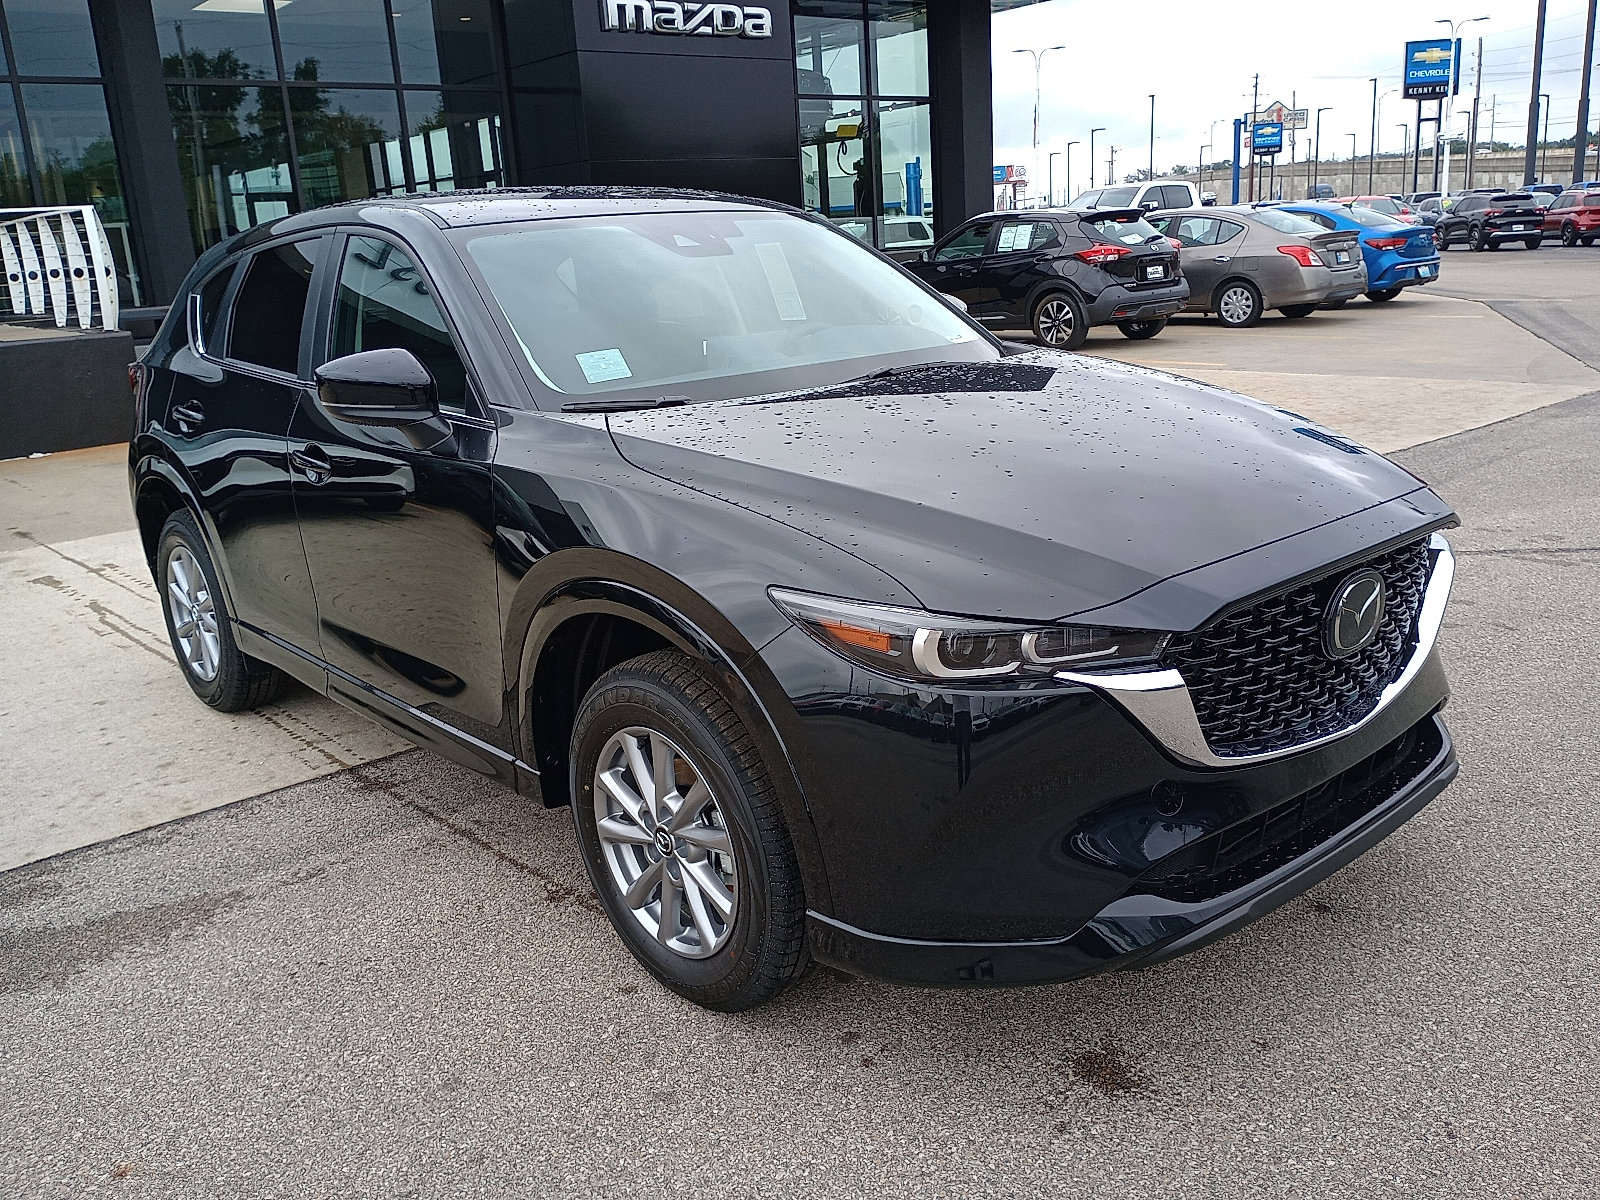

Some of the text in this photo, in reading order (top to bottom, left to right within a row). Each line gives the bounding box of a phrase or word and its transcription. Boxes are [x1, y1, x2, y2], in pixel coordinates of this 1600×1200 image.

[601, 0, 773, 38] mazda
[1409, 69, 1450, 78] CHEVROLE
[1408, 86, 1433, 95] KENNY
